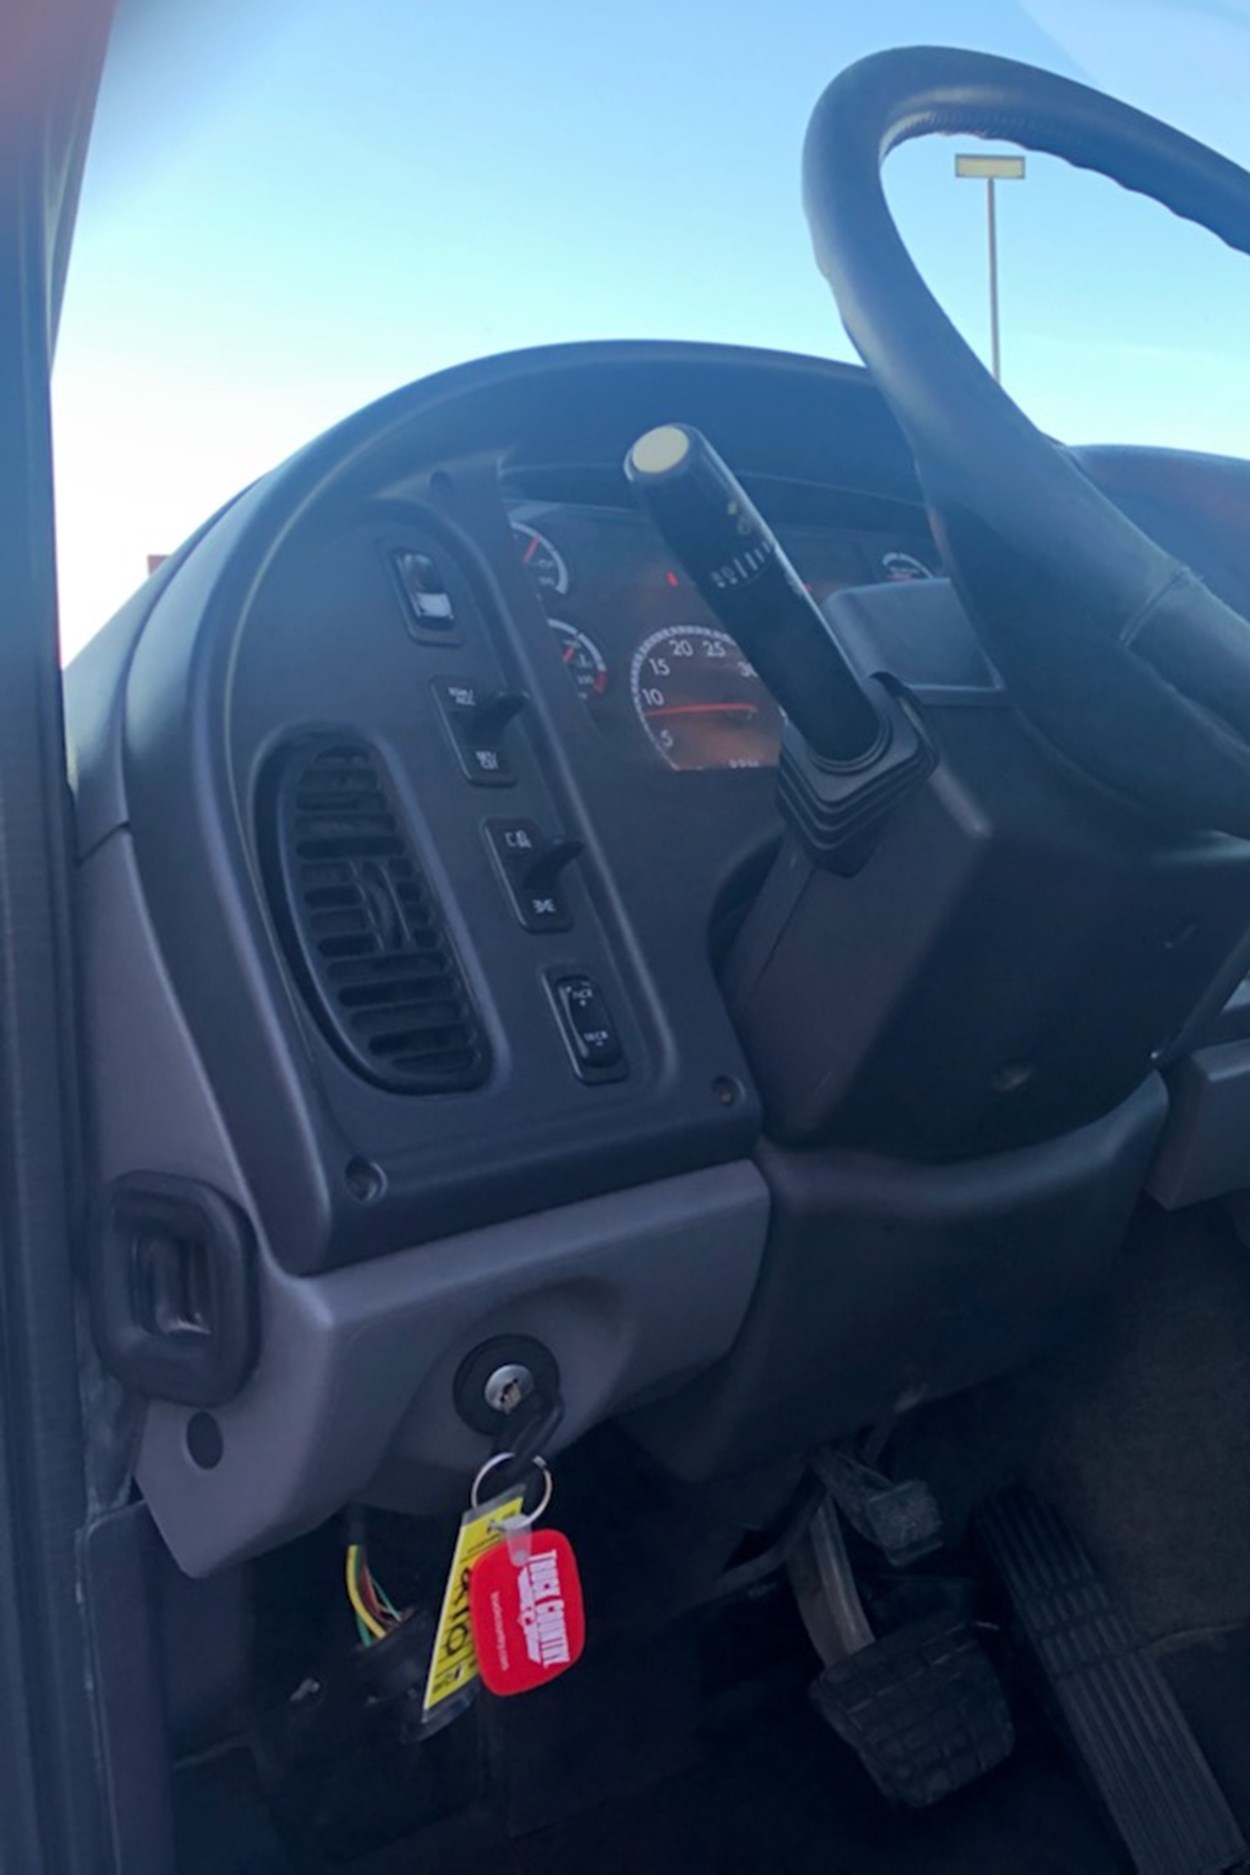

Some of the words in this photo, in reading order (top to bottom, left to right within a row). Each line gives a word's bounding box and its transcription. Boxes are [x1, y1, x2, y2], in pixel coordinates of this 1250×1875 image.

[669, 639, 694, 657] 20
[702, 640, 726, 658] 25
[649, 658, 671, 676] 15
[642, 688, 665, 706] 10
[661, 729, 674, 748] 5
[529, 1550, 561, 1598] TRUCK
[536, 1599, 570, 1668] COUNTRY
